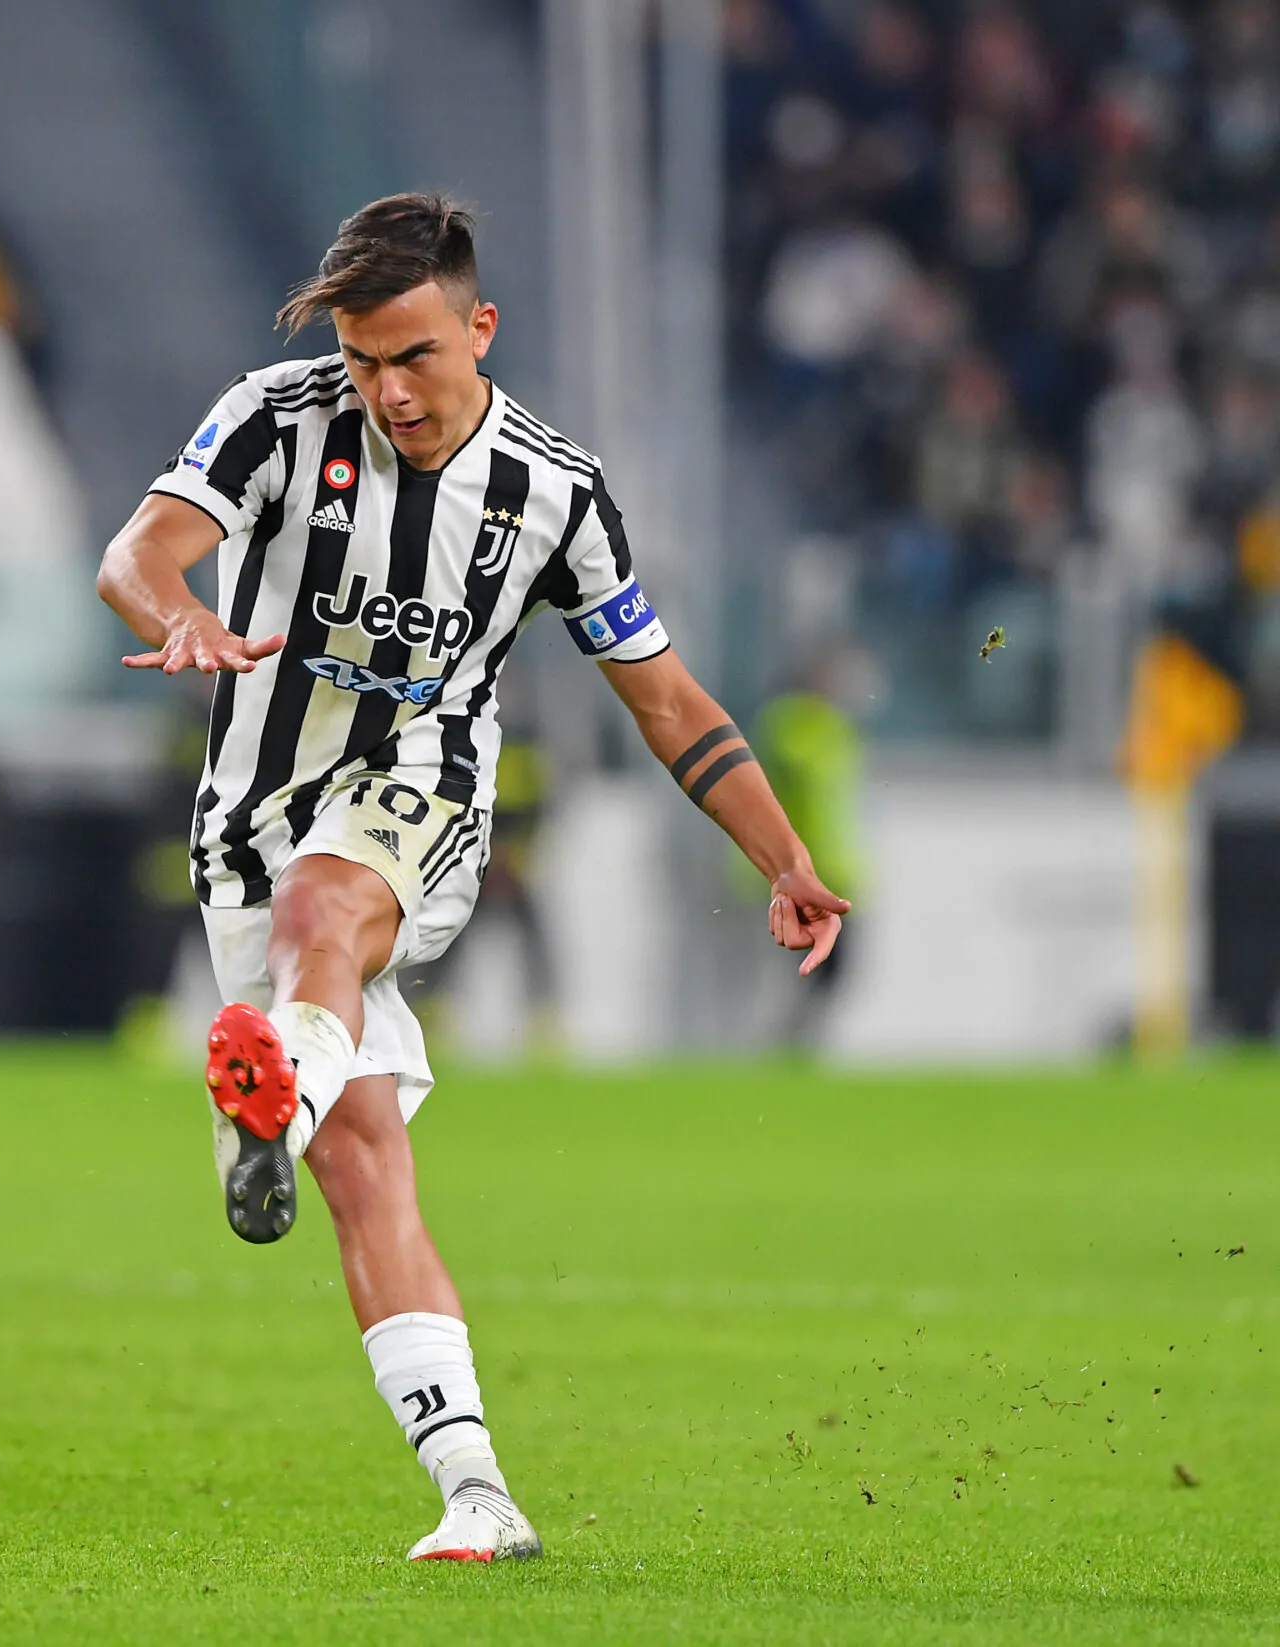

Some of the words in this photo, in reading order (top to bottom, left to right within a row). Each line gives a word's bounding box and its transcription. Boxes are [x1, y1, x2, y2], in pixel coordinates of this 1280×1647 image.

[308, 515, 355, 533] adidas
[313, 571, 473, 662] Jeep
[349, 778, 430, 826] 10
[363, 829, 401, 862] adidas
